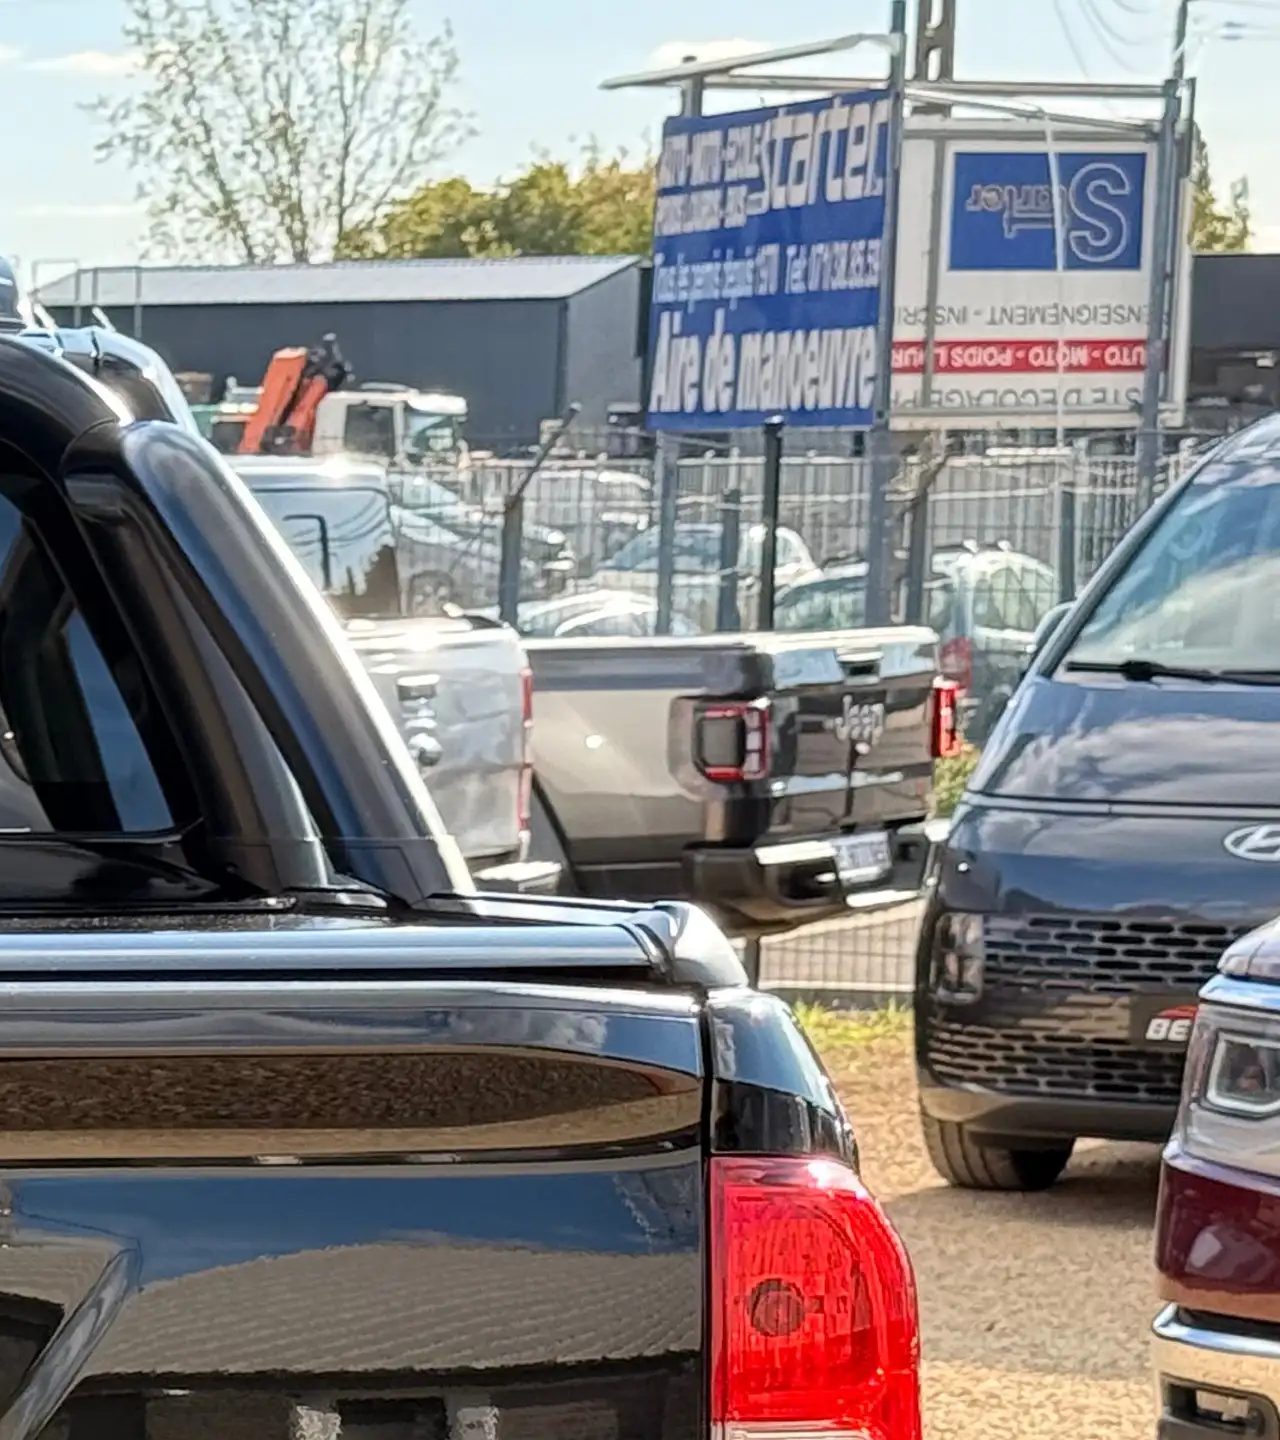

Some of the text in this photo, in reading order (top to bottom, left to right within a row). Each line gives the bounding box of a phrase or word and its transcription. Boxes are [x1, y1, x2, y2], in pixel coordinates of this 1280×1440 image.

[987, 303, 1150, 327] NSEIGNEMENT
[702, 308, 735, 413] de
[736, 326, 877, 413] manoeuvre
[950, 345, 1012, 368] POIDS
[1103, 346, 1147, 368] UTO
